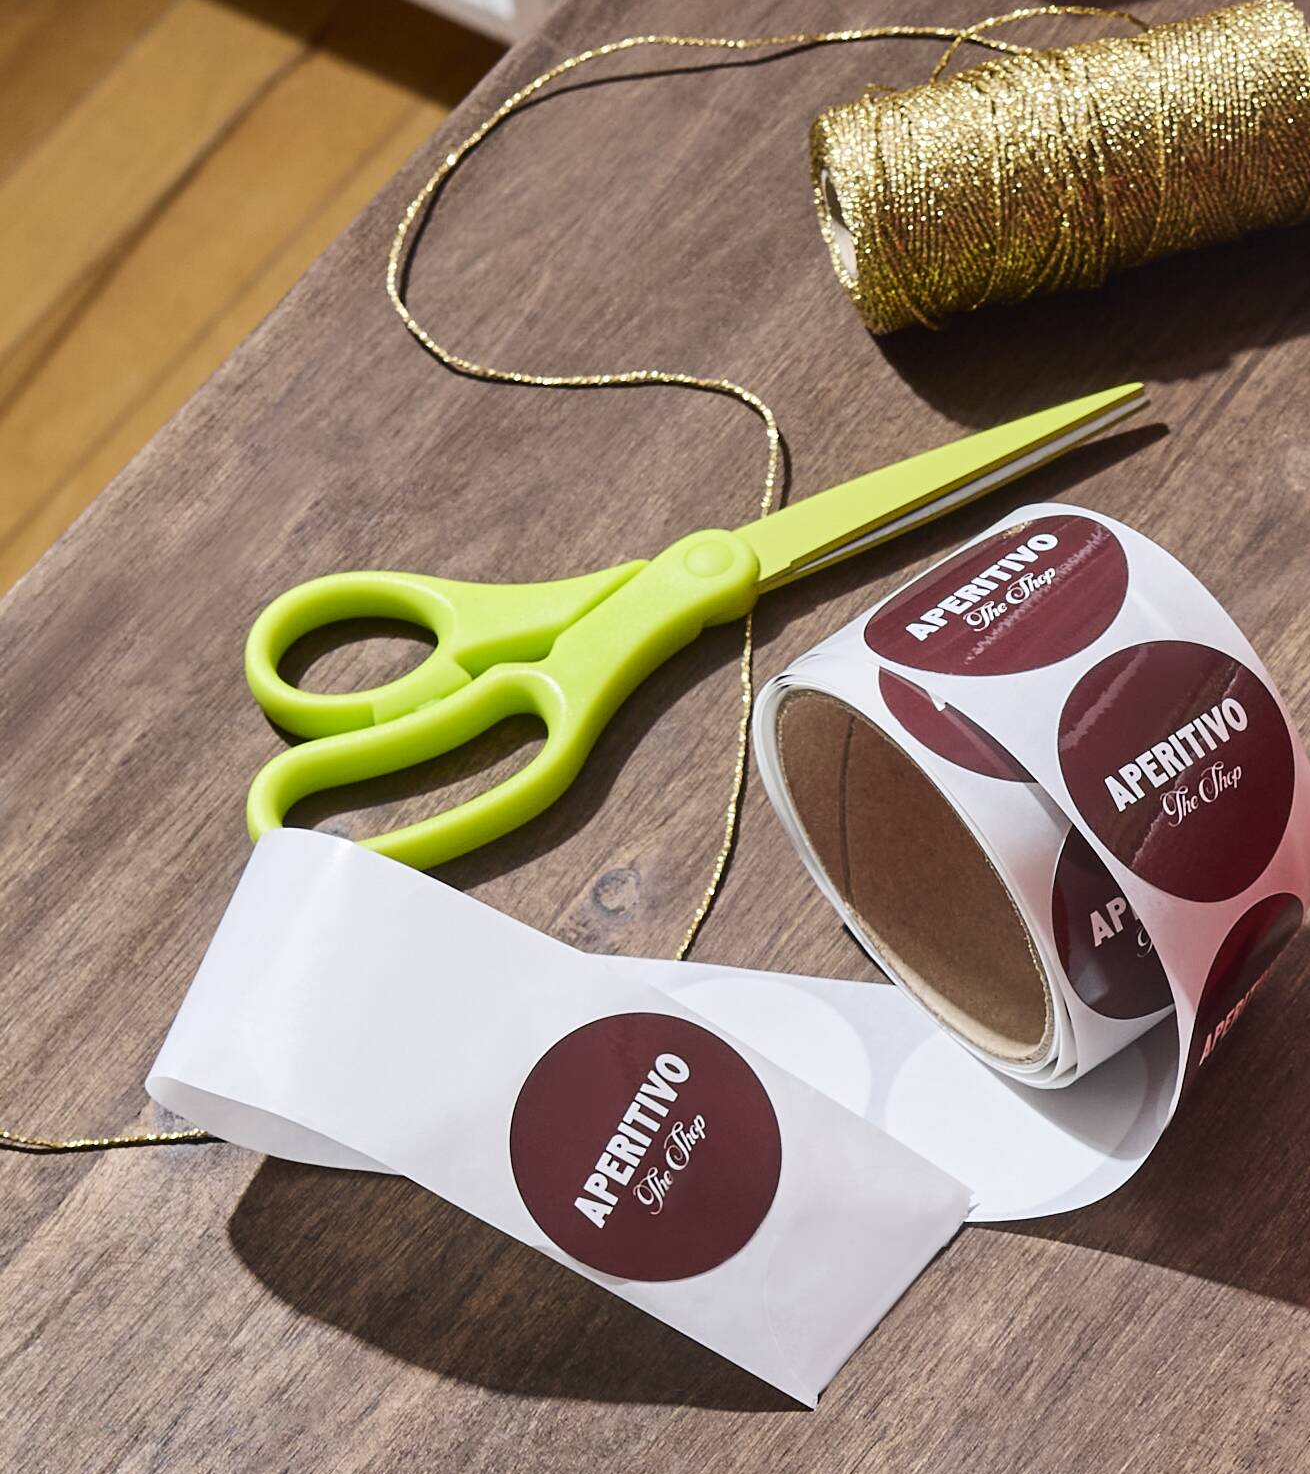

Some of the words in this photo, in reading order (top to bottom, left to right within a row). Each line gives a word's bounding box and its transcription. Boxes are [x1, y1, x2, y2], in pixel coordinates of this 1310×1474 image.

[904, 531, 1060, 642] APERITIVO
[963, 594, 1007, 633] The
[1008, 566, 1057, 609] Shop
[1104, 697, 1249, 813] APERITIVO
[1161, 785, 1198, 828] The
[1198, 760, 1244, 809] Shop
[574, 1051, 692, 1229] APERITIVO
[634, 1163, 675, 1217] The
[667, 1110, 708, 1172] Shop
